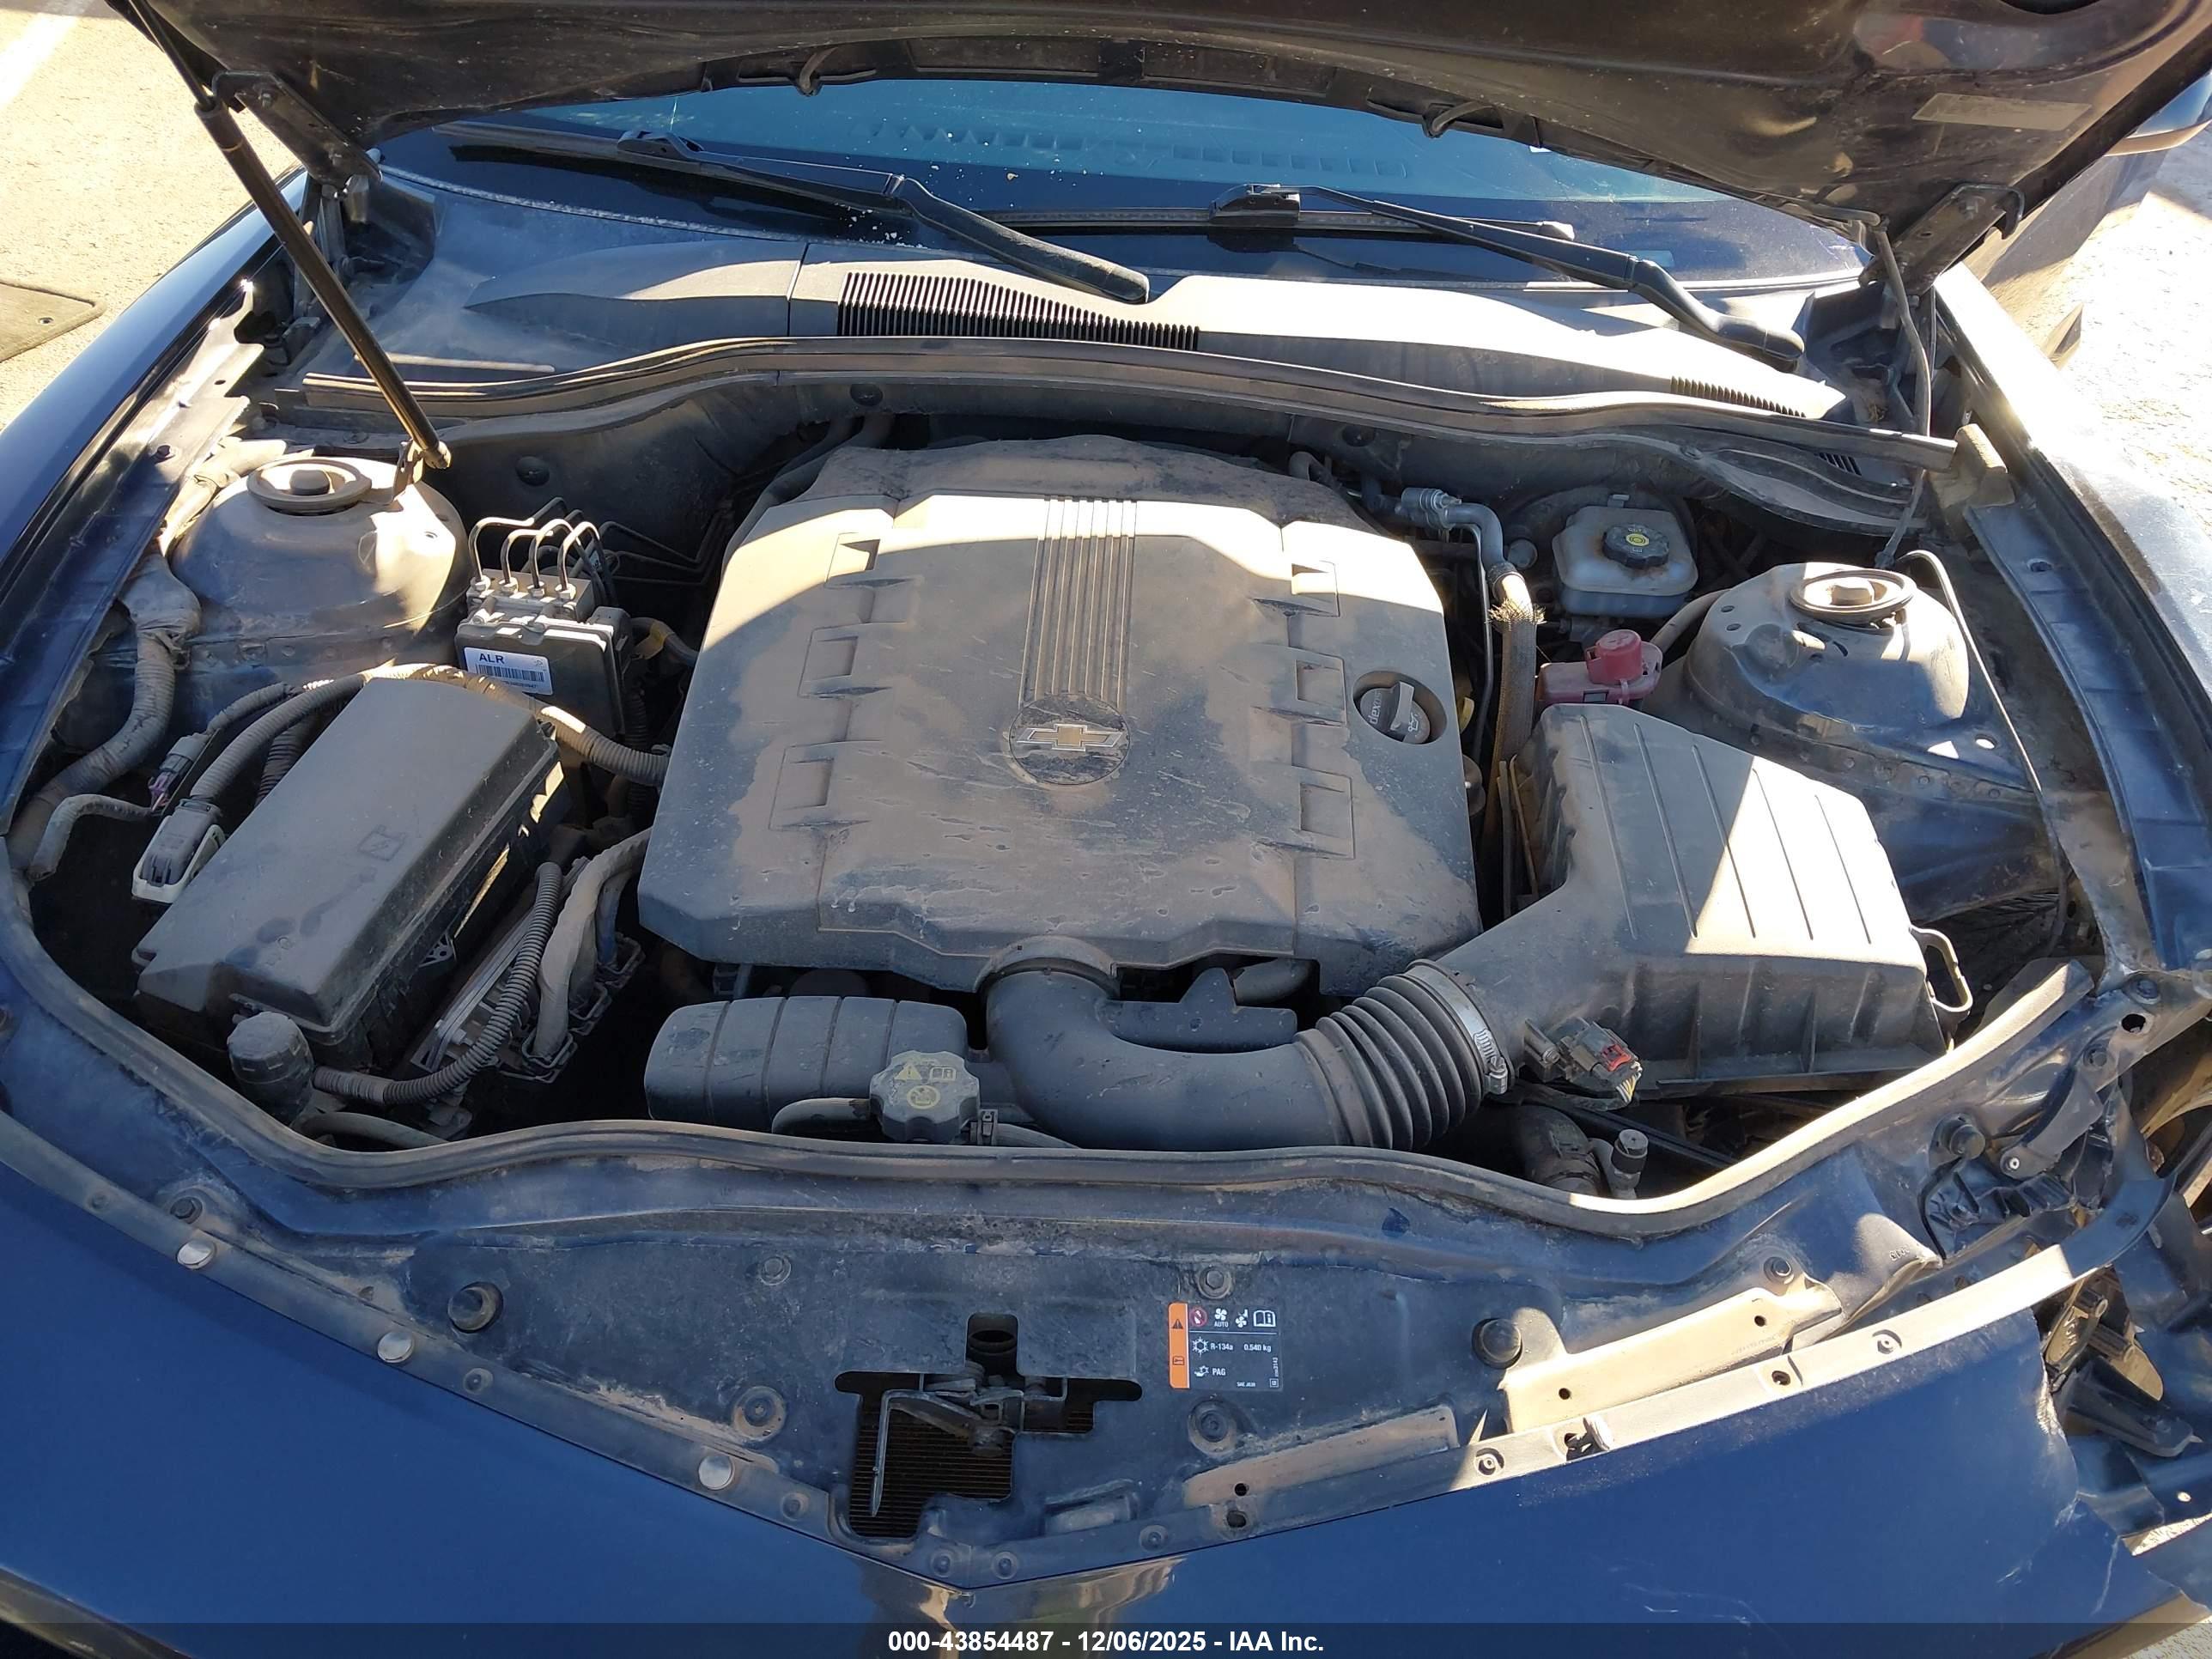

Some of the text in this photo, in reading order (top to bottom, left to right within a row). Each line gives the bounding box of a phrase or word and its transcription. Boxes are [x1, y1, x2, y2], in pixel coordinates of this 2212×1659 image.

[479, 653, 505, 665] ALR
[1368, 690, 1382, 725] dexos
[1262, 1344, 1272, 1352] kg
